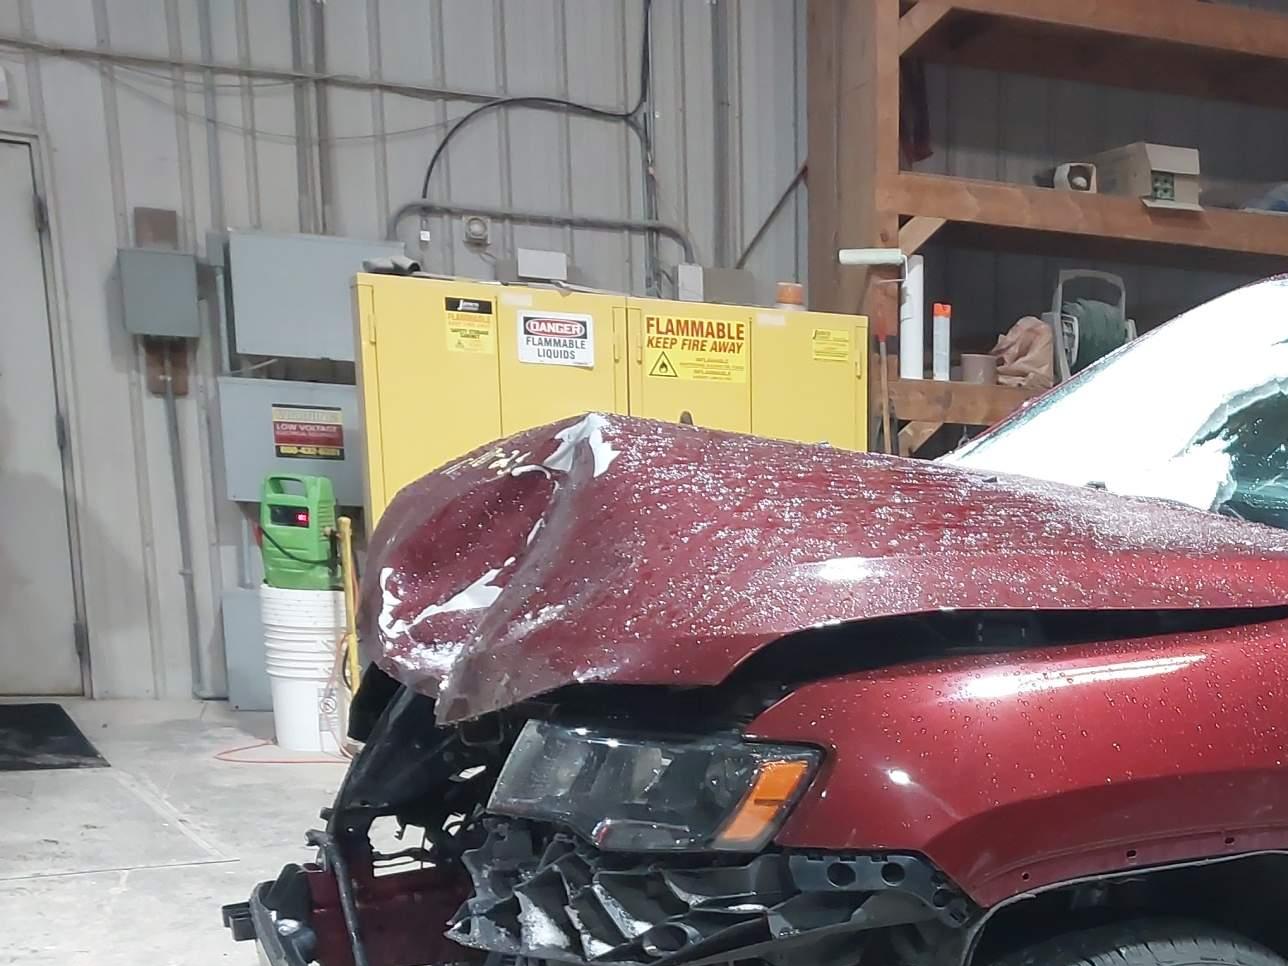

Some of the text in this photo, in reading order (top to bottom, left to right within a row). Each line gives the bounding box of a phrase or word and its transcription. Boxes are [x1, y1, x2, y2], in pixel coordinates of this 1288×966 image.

[529, 321, 580, 334] DANGER
[646, 317, 745, 340] FLAMMABLE
[526, 336, 586, 349] FLAMMABLE
[647, 336, 744, 354] KEEP FIRE AWAY
[537, 348, 576, 360] LIQUIDS
[276, 423, 297, 431] LOW
